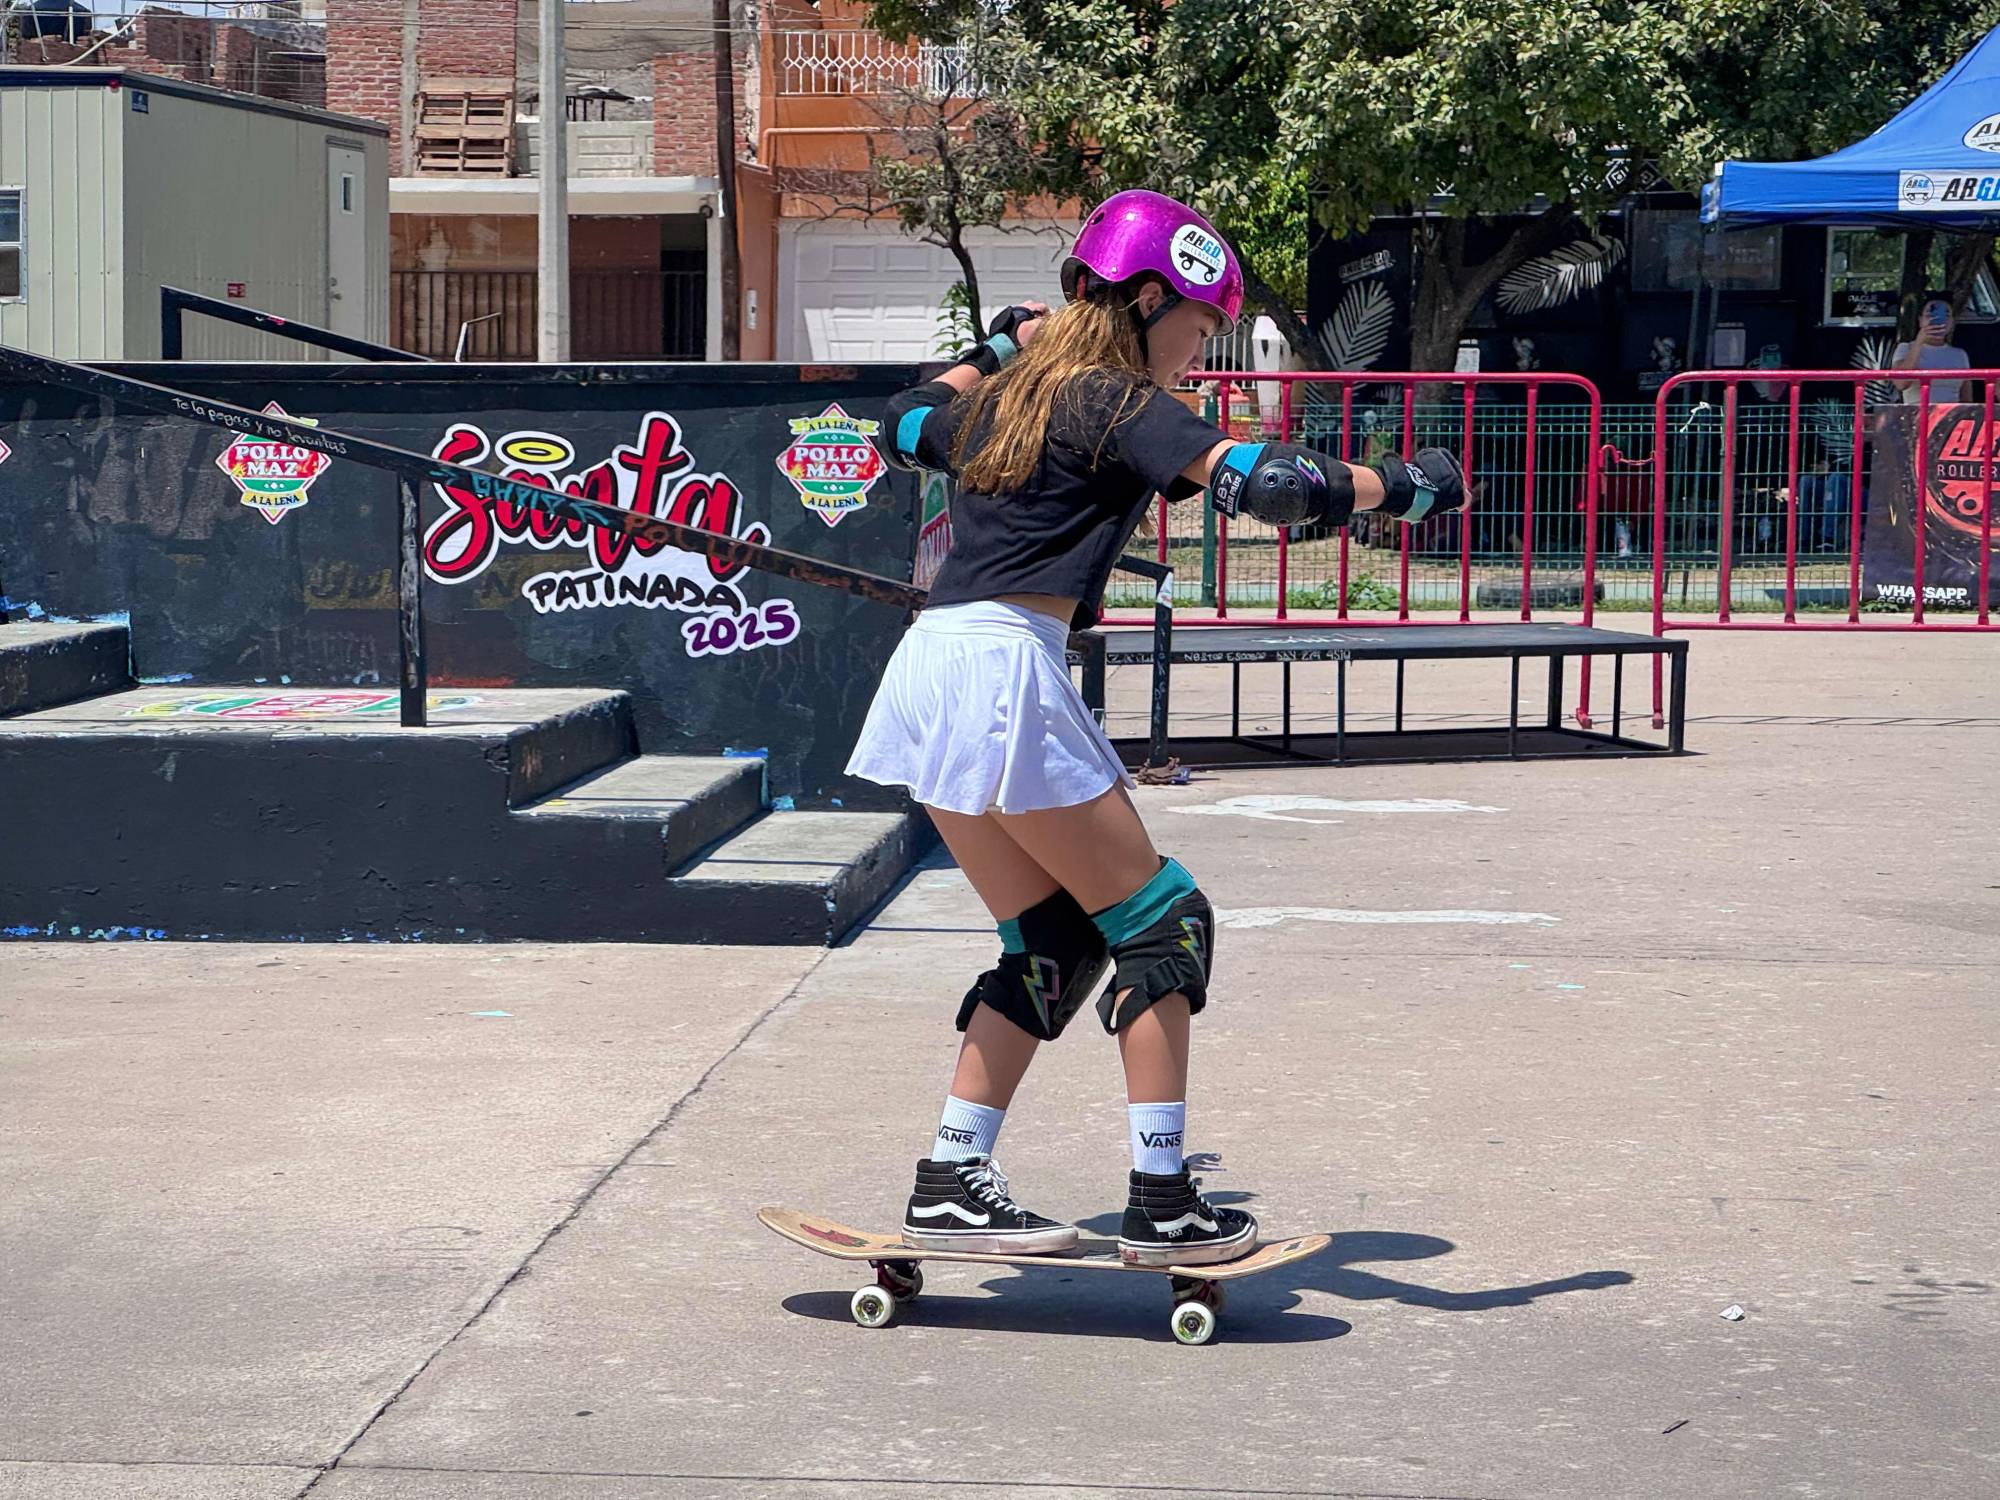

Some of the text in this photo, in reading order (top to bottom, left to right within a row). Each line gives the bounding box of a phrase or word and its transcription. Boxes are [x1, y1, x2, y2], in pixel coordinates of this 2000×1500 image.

[818, 421, 831, 430] LA
[235, 445, 310, 460] POLLO
[794, 447, 870, 463] POLLO
[247, 462, 298, 476] MAZ
[806, 464, 859, 478] MAZ
[1215, 472, 1232, 508] 187
[259, 496, 272, 506] LA
[818, 498, 830, 508] LA
[528, 572, 741, 616] PATINADA
[1877, 584, 1968, 599] WHASAPP
[687, 604, 796, 652] 2025
[938, 1124, 976, 1145] VANS
[1138, 1130, 1183, 1149] VANS
